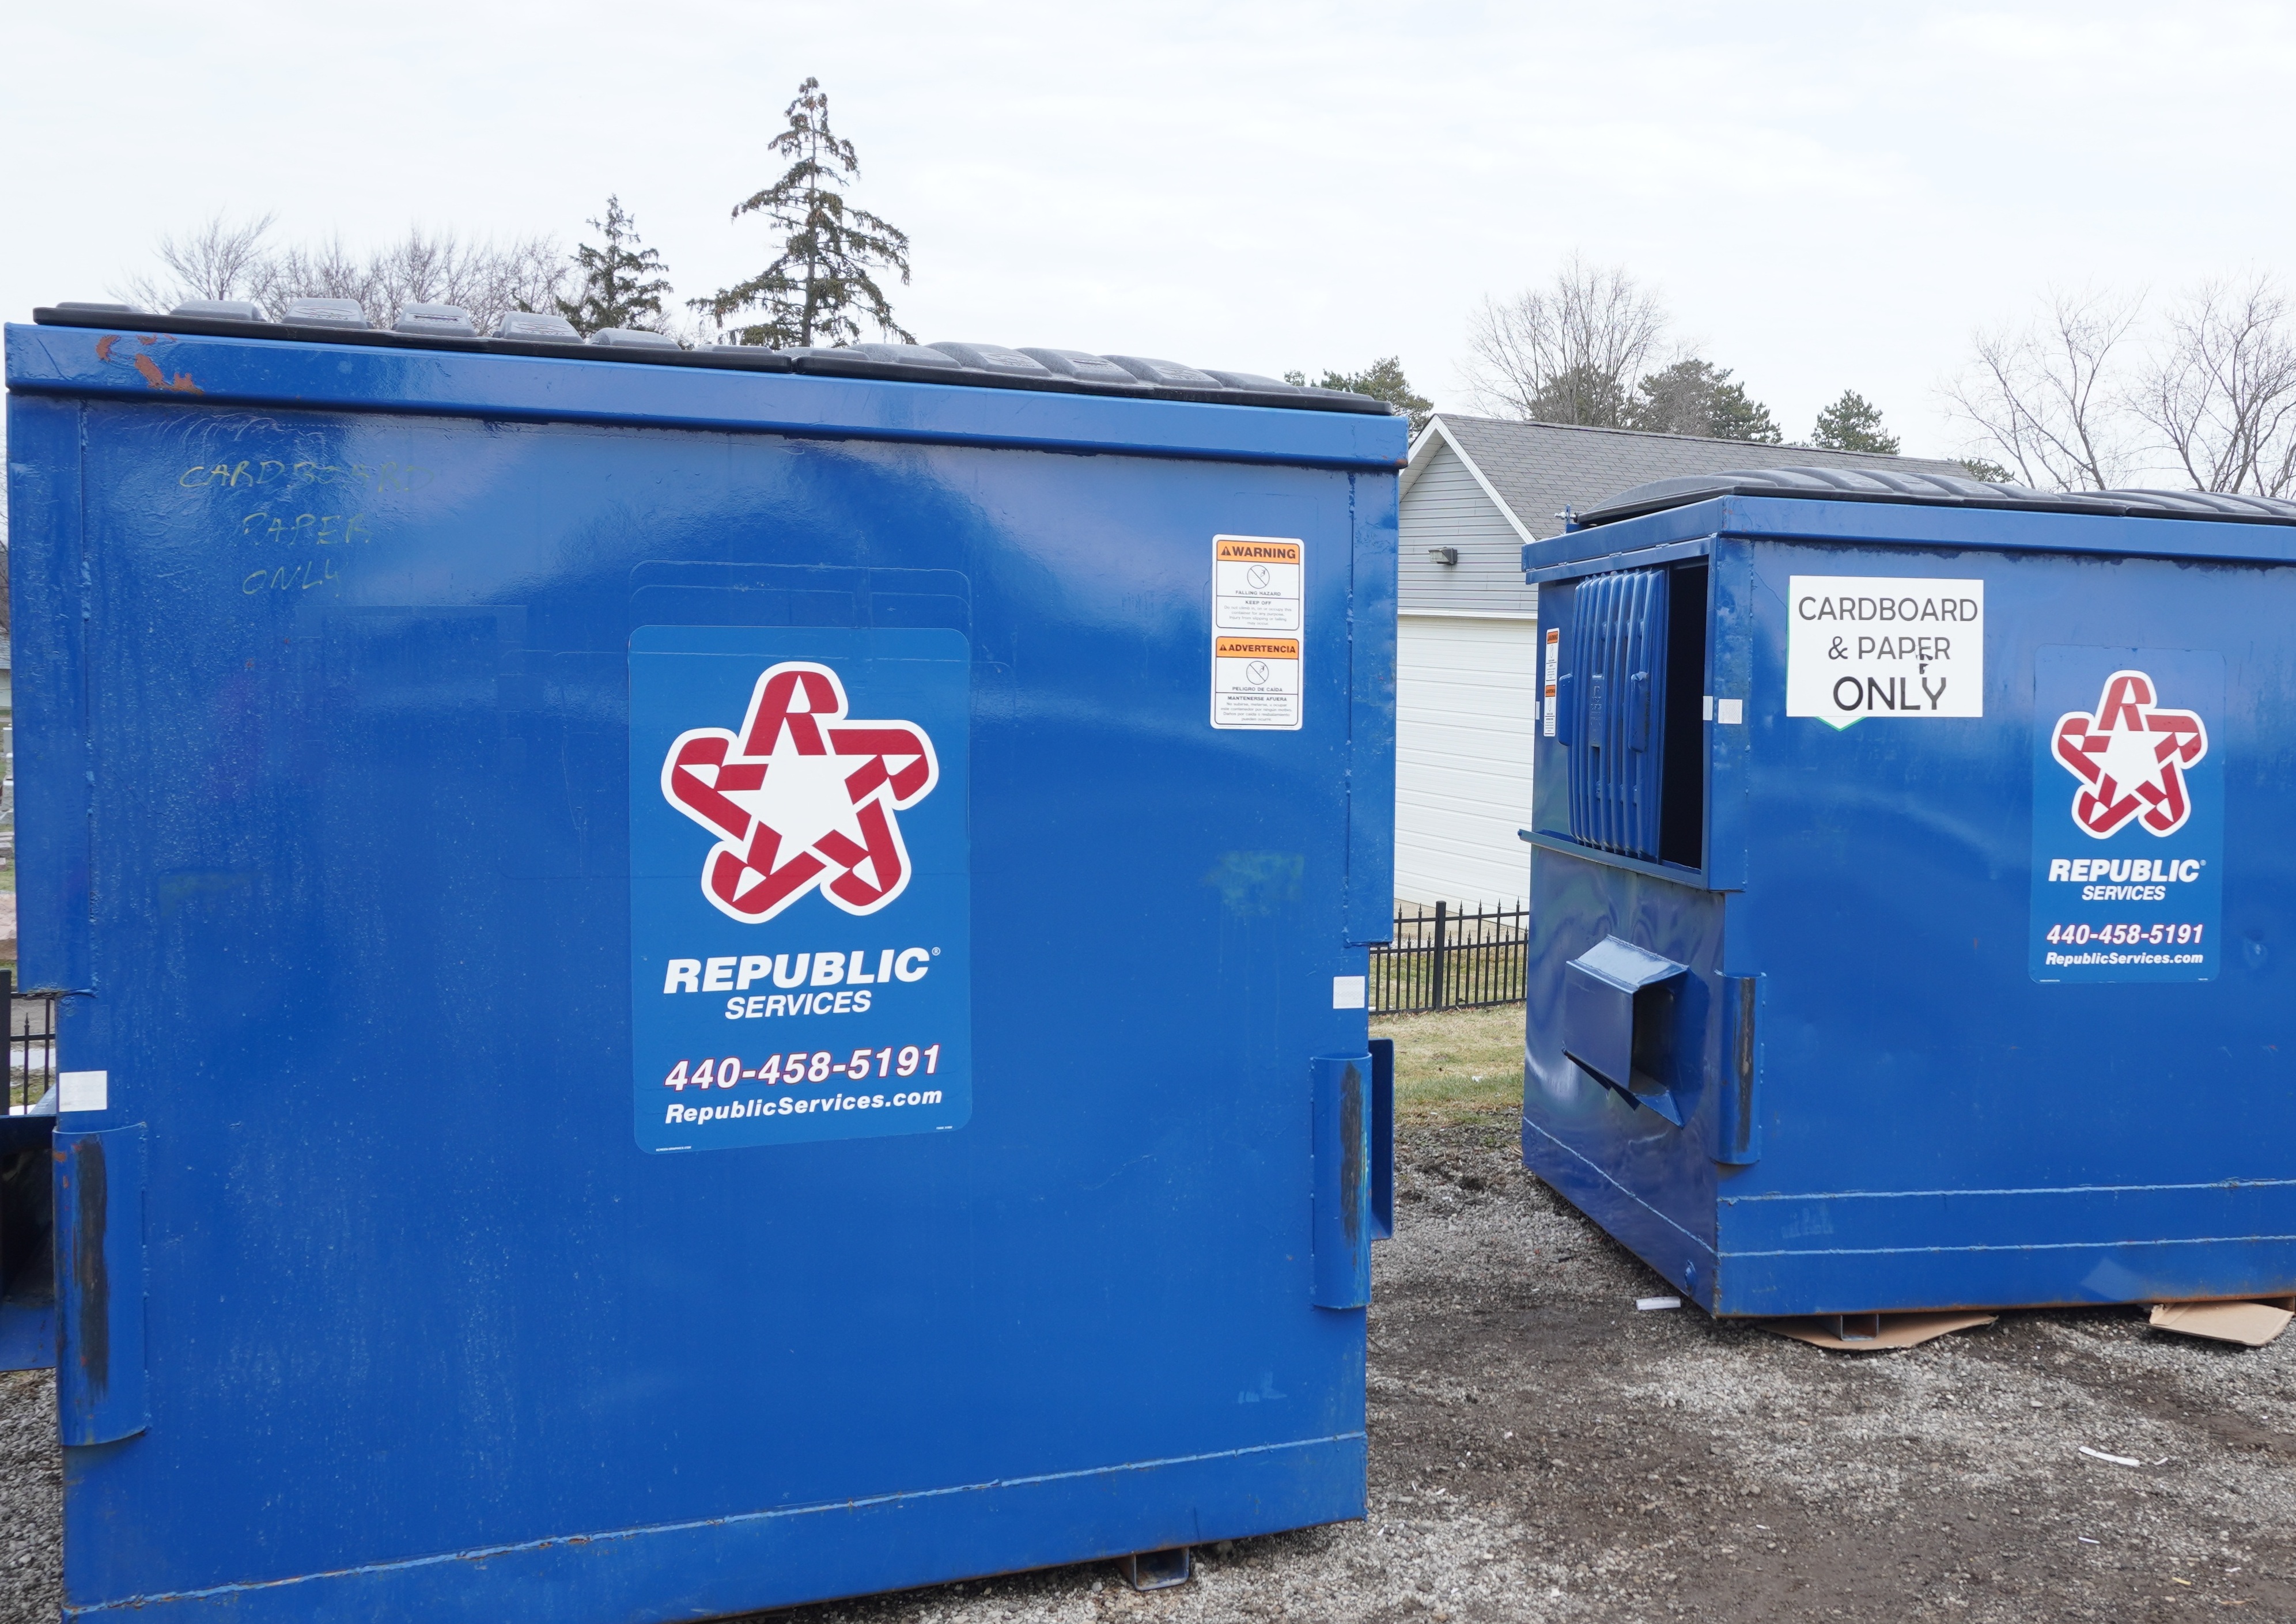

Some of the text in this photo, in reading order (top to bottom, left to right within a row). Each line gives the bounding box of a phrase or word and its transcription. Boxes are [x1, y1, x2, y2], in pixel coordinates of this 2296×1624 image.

[180, 460, 434, 493] CARDBOARD
[234, 512, 372, 546] PAPER
[1232, 546, 1296, 559] WARNING
[243, 559, 339, 597] ONLY
[1799, 596, 1977, 622] CARDBOARD
[1228, 644, 1296, 653] ADVERTENCIA
[1828, 636, 1951, 660] & PAPER
[1833, 676, 1946, 711] ONLY
[2082, 885, 2166, 901] SERVICES
[2046, 923, 2204, 945] 440-458-5191
[2045, 952, 2204, 967] RepublicServices.com
[724, 990, 873, 1020] SERVICES
[664, 1043, 941, 1092] 440-458-5191
[665, 1090, 943, 1125] RepublicServices.com
